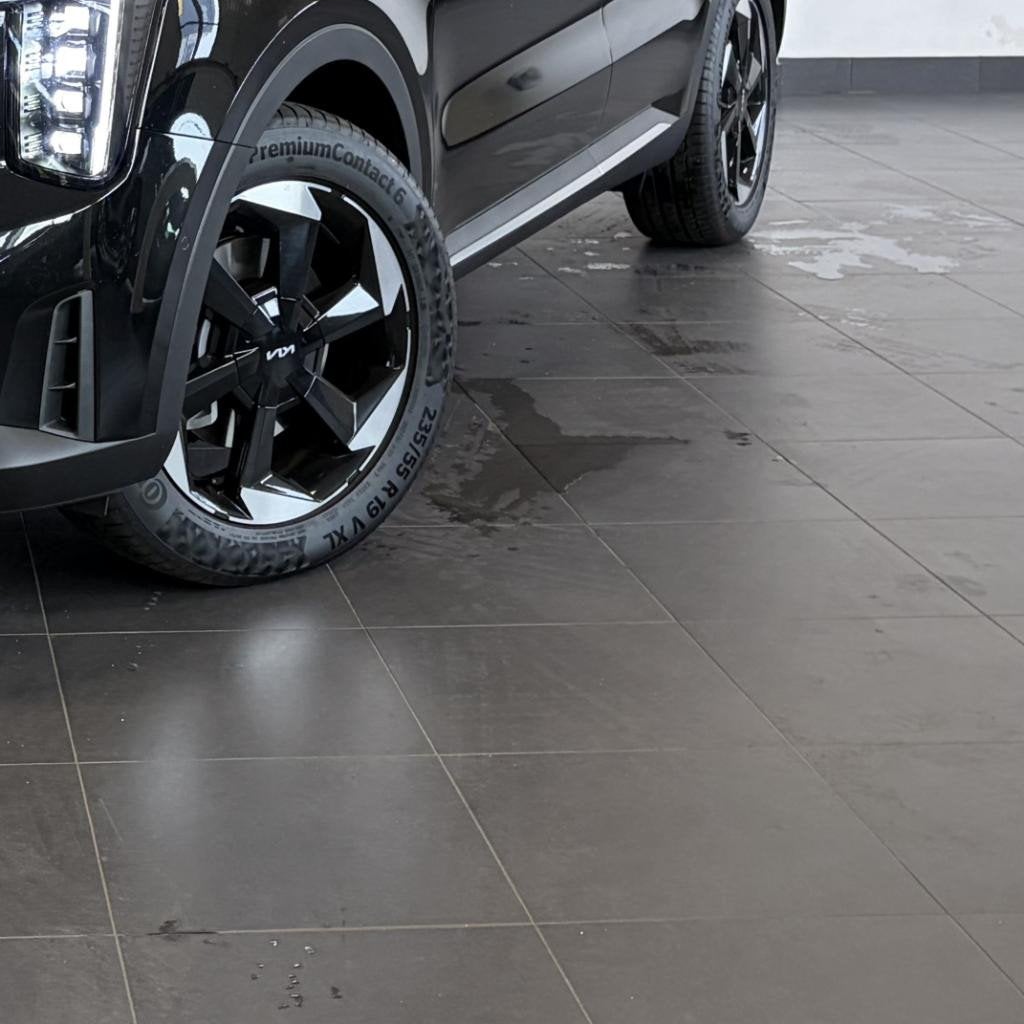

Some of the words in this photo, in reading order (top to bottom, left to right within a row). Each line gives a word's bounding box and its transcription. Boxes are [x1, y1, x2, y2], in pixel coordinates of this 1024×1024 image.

[392, 187, 407, 206] 6
[395, 405, 437, 480] 235/55
[381, 480, 399, 498] R
[366, 496, 387, 518] 19
[351, 516, 365, 535] V
[323, 525, 348, 550] XL
